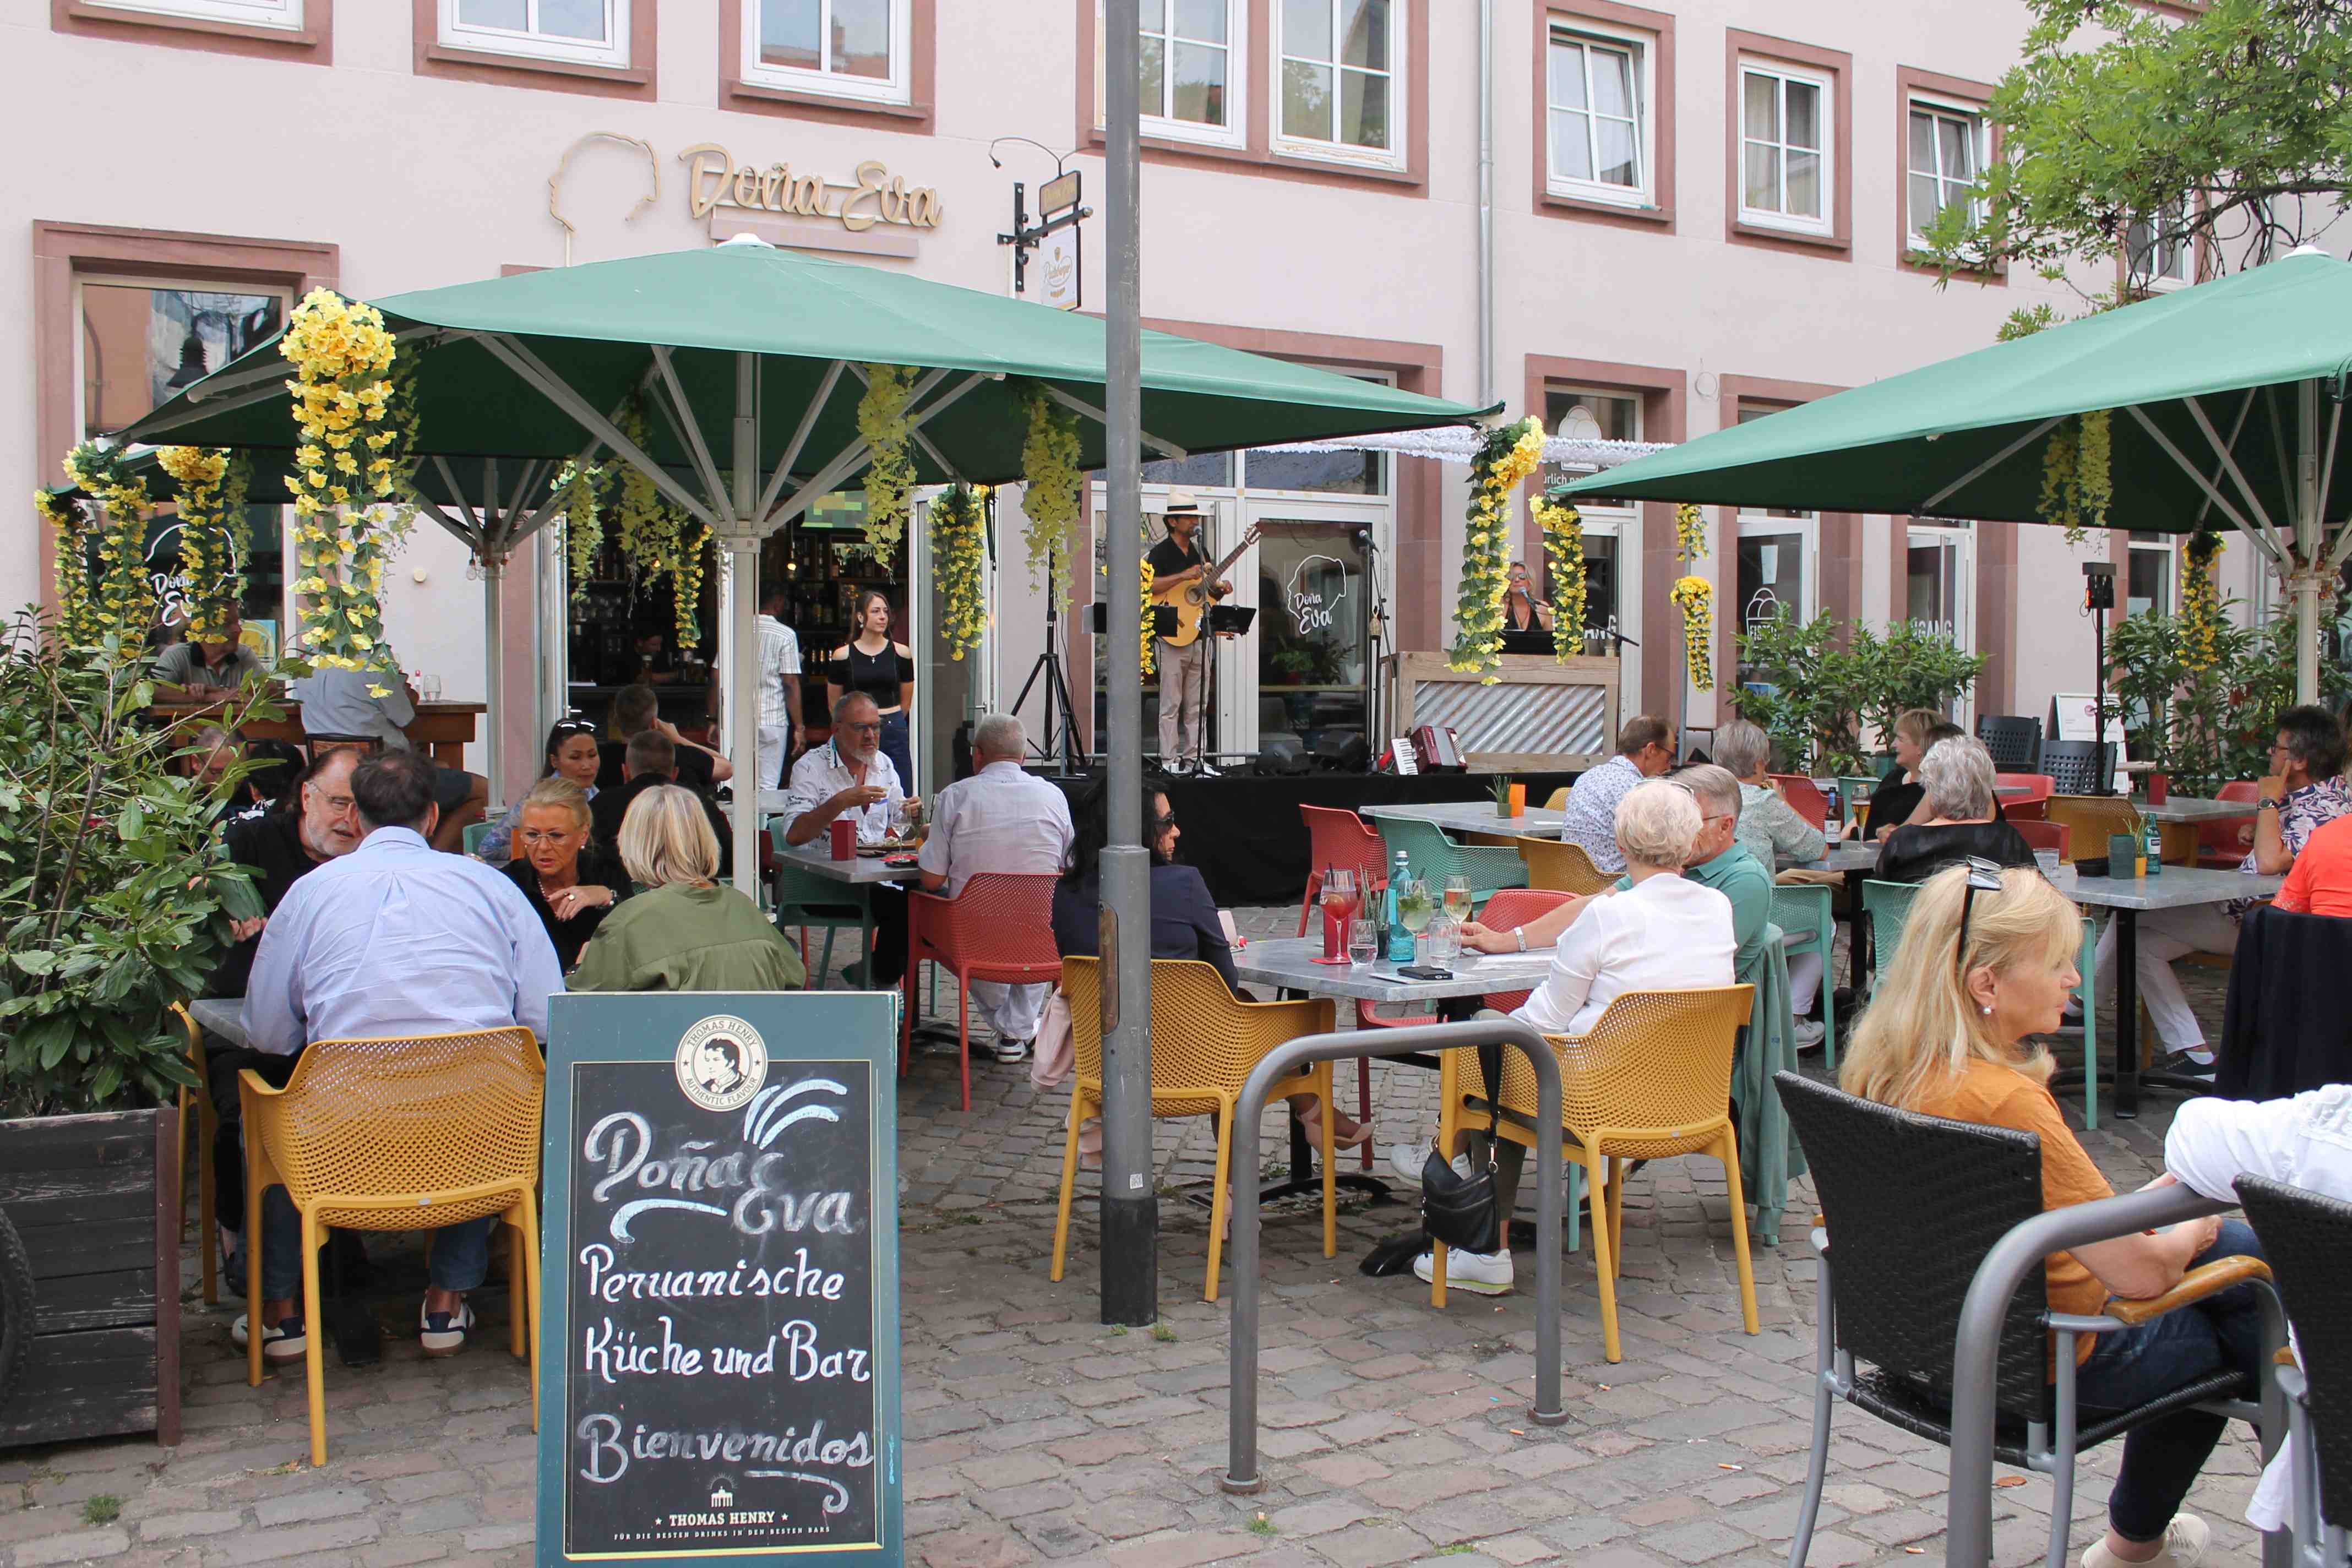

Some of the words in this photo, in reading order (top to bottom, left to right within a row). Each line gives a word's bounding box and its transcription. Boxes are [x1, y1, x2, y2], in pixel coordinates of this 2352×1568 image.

[678, 142, 830, 219] Doña
[842, 161, 943, 231] Eva
[1299, 607, 1332, 634] Eva
[687, 1021, 724, 1046] THOMAS
[728, 1021, 758, 1046] HENRY
[685, 1077, 724, 1104] AUTHENTIC
[727, 1076, 758, 1104] FLAVOUR
[584, 1111, 745, 1202] Doña
[733, 1152, 854, 1235] Eva
[580, 1243, 845, 1303] Peruanische
[585, 1316, 703, 1383] Küche
[711, 1335, 776, 1378] und
[781, 1319, 870, 1382] Bar
[576, 1413, 874, 1484] Bienvenidos
[614, 1532, 630, 1540] FÜR
[656, 1531, 690, 1539] BESTEN
[694, 1530, 728, 1538] DRINKS
[770, 1527, 803, 1536] BESTEN
[808, 1526, 831, 1534] BARS
[669, 1512, 725, 1527] THOMAS
[729, 1511, 776, 1525] HENRY
